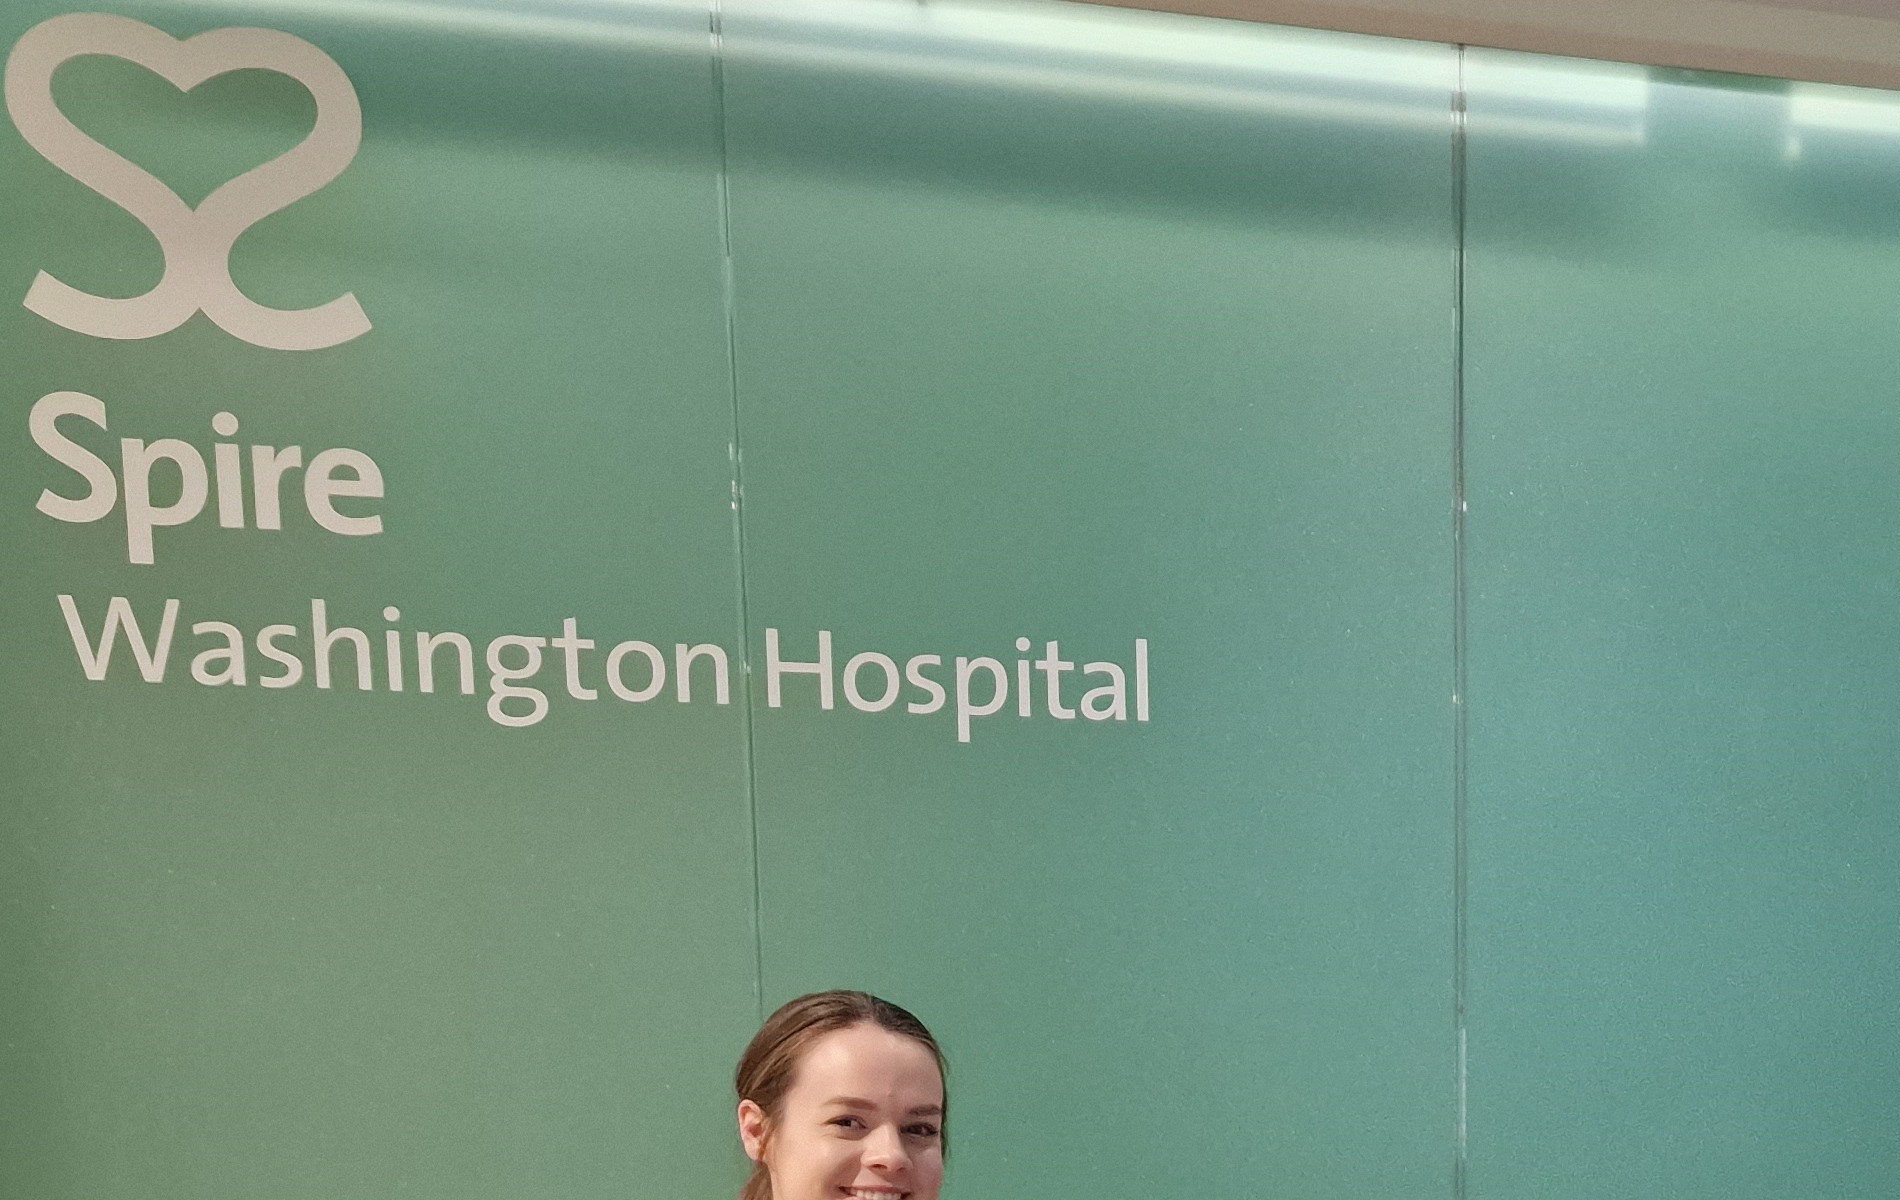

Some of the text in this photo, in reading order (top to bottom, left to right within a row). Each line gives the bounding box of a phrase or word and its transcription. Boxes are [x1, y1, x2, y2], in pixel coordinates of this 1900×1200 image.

[28, 390, 386, 565] Spire
[57, 593, 1150, 743] Washington Hospital
